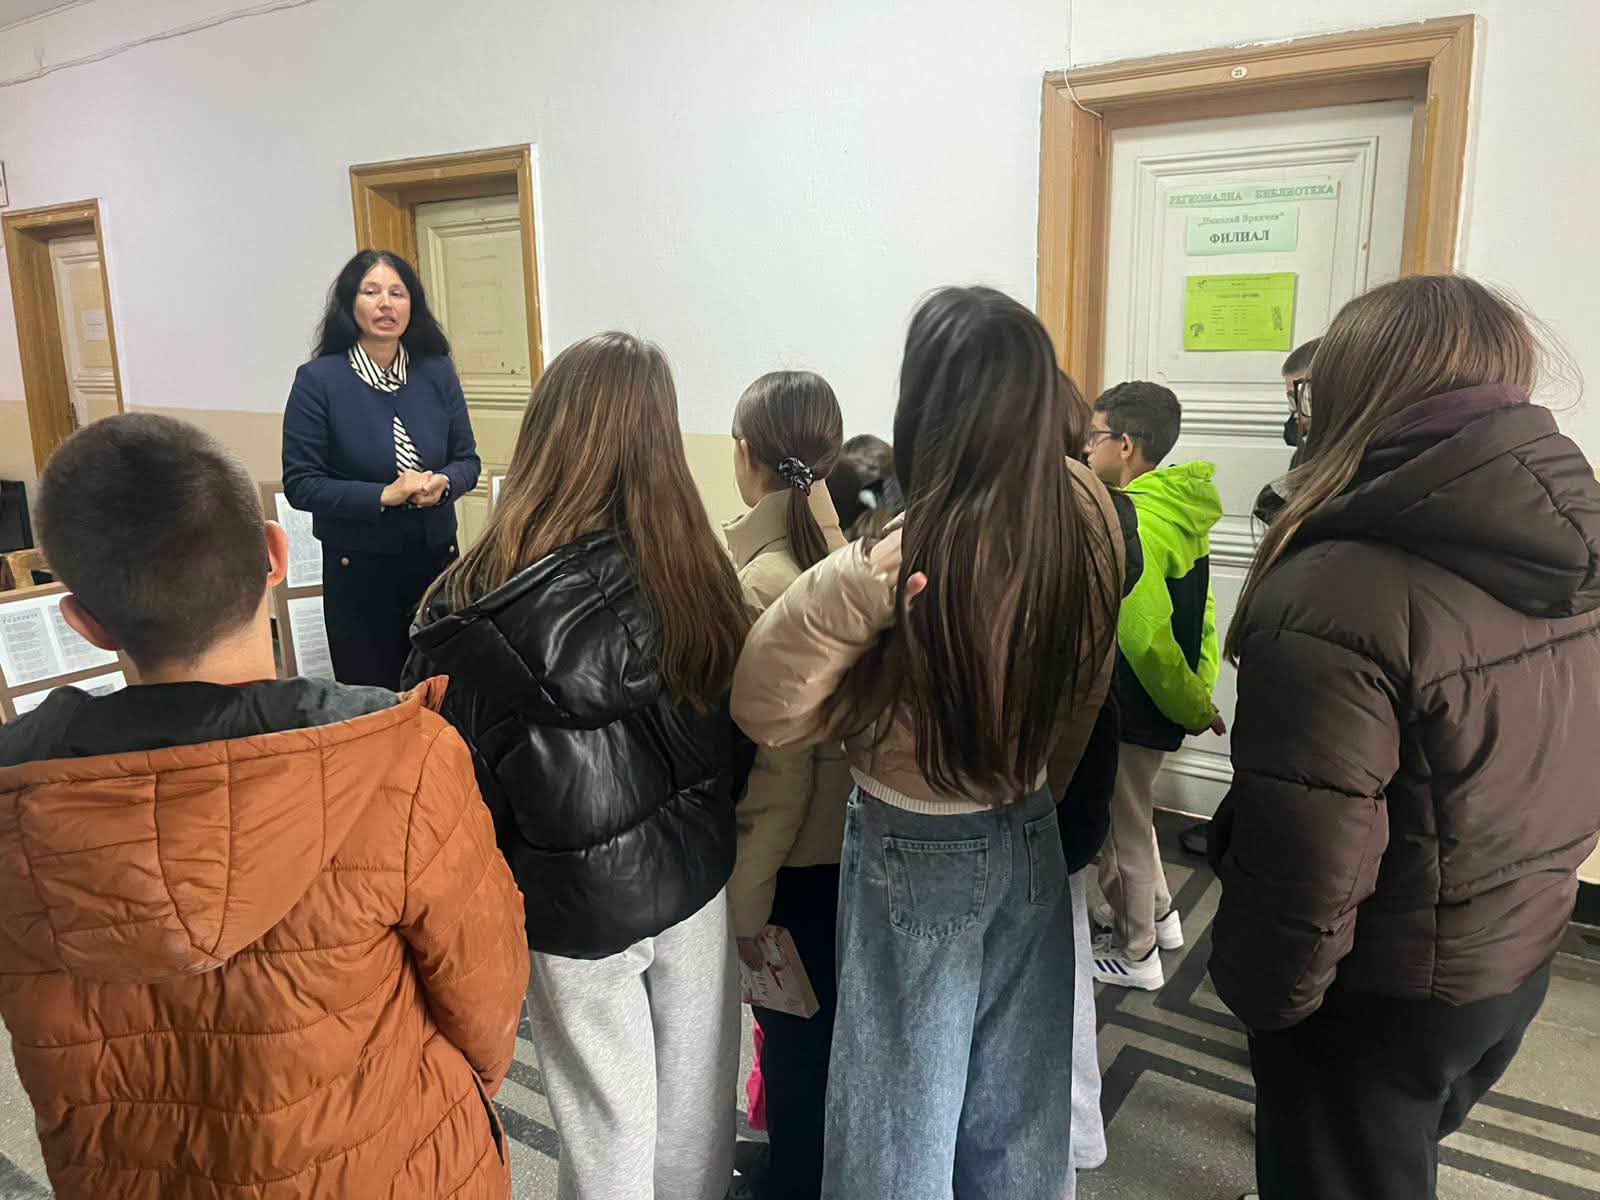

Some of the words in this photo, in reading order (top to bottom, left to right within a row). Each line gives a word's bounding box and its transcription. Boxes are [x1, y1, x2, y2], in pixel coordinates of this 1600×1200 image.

[1168, 191, 1243, 205] РЕГИОНАЛНА
[1255, 184, 1334, 200] БИБЛИОТЕКА
[1209, 230, 1270, 244] ФИЛИАЛ
